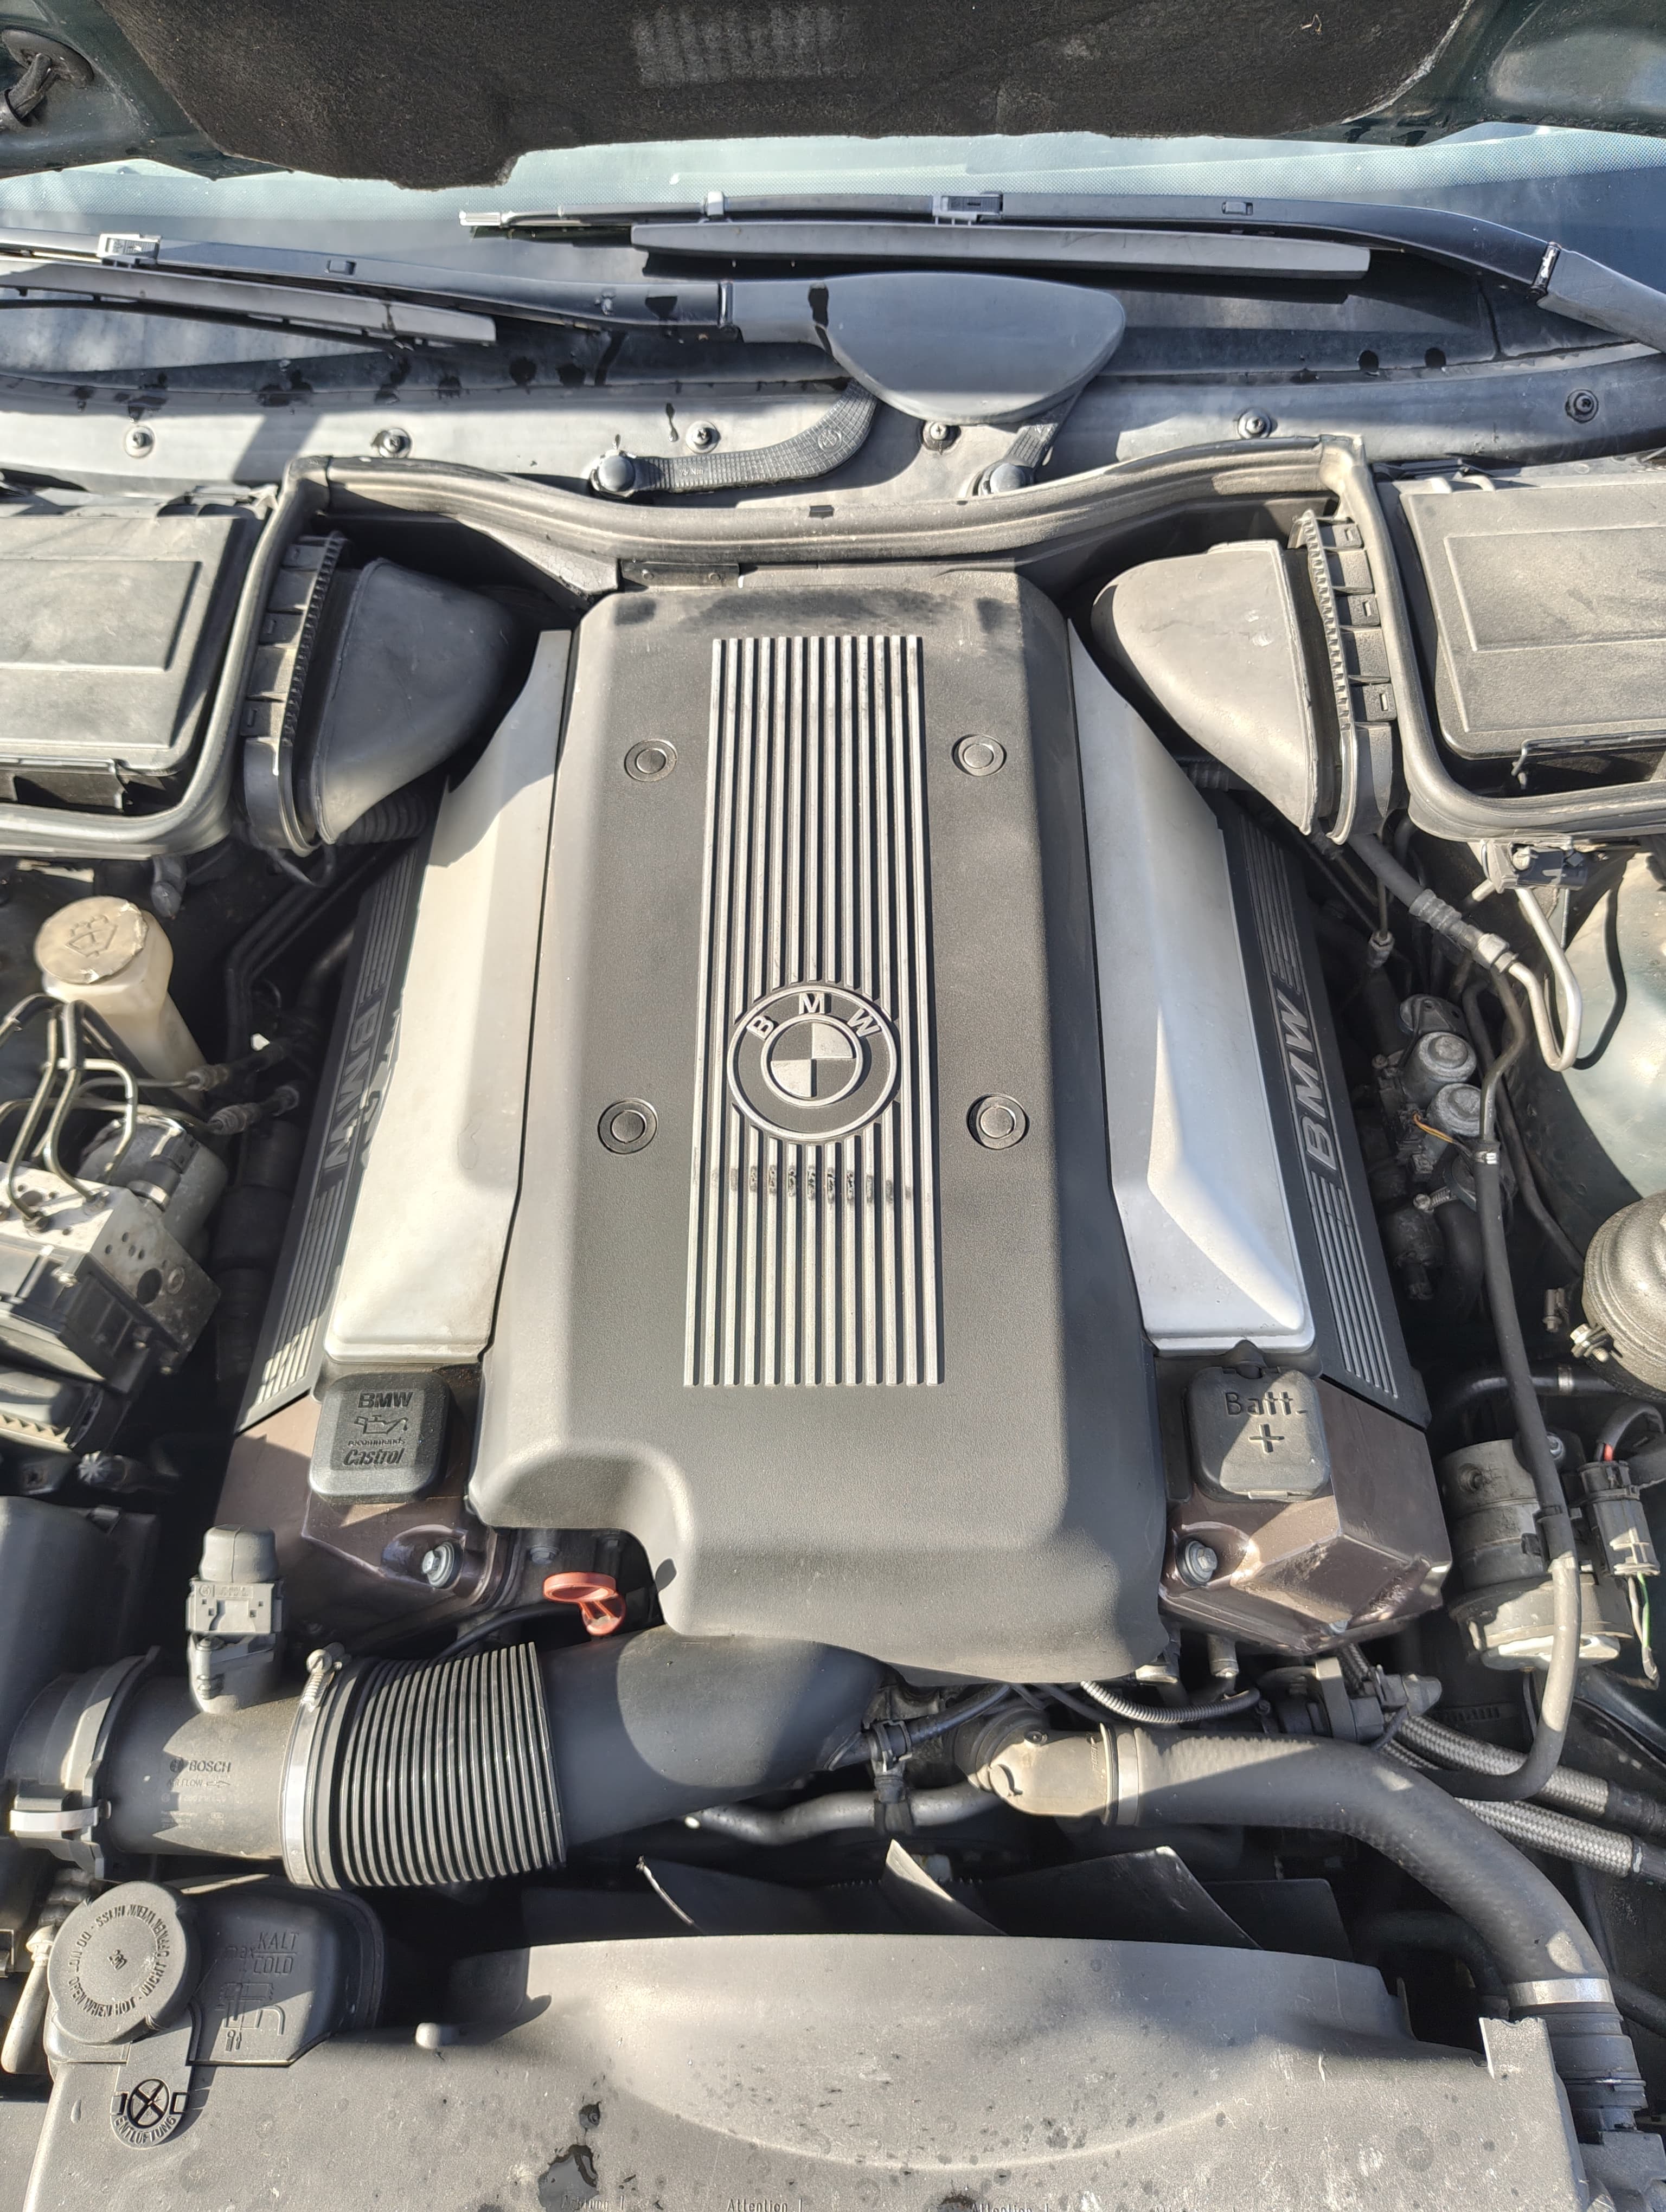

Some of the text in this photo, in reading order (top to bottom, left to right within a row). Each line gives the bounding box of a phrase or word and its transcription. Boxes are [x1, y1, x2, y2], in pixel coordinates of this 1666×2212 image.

[746, 992, 882, 1041] BMW
[325, 1001, 381, 1170] BMW
[1277, 988, 1336, 1171] BMW
[358, 1392, 413, 1408] BMW
[348, 1437, 406, 1446] recommends
[343, 1448, 405, 1465] Castrol
[189, 1760, 232, 1773] BOSCH
[182, 1778, 203, 1787] FLOW
[76, 1931, 92, 1947] DO
[258, 1931, 299, 1950] KALT
[254, 1956, 293, 1974] COLD
[139, 1961, 167, 1997] NICHT
[68, 1976, 87, 2005] OPEN
[83, 1997, 112, 2017] WHEN
[114, 1996, 136, 2016] HOT
[727, 2198, 787, 2212] Attention
